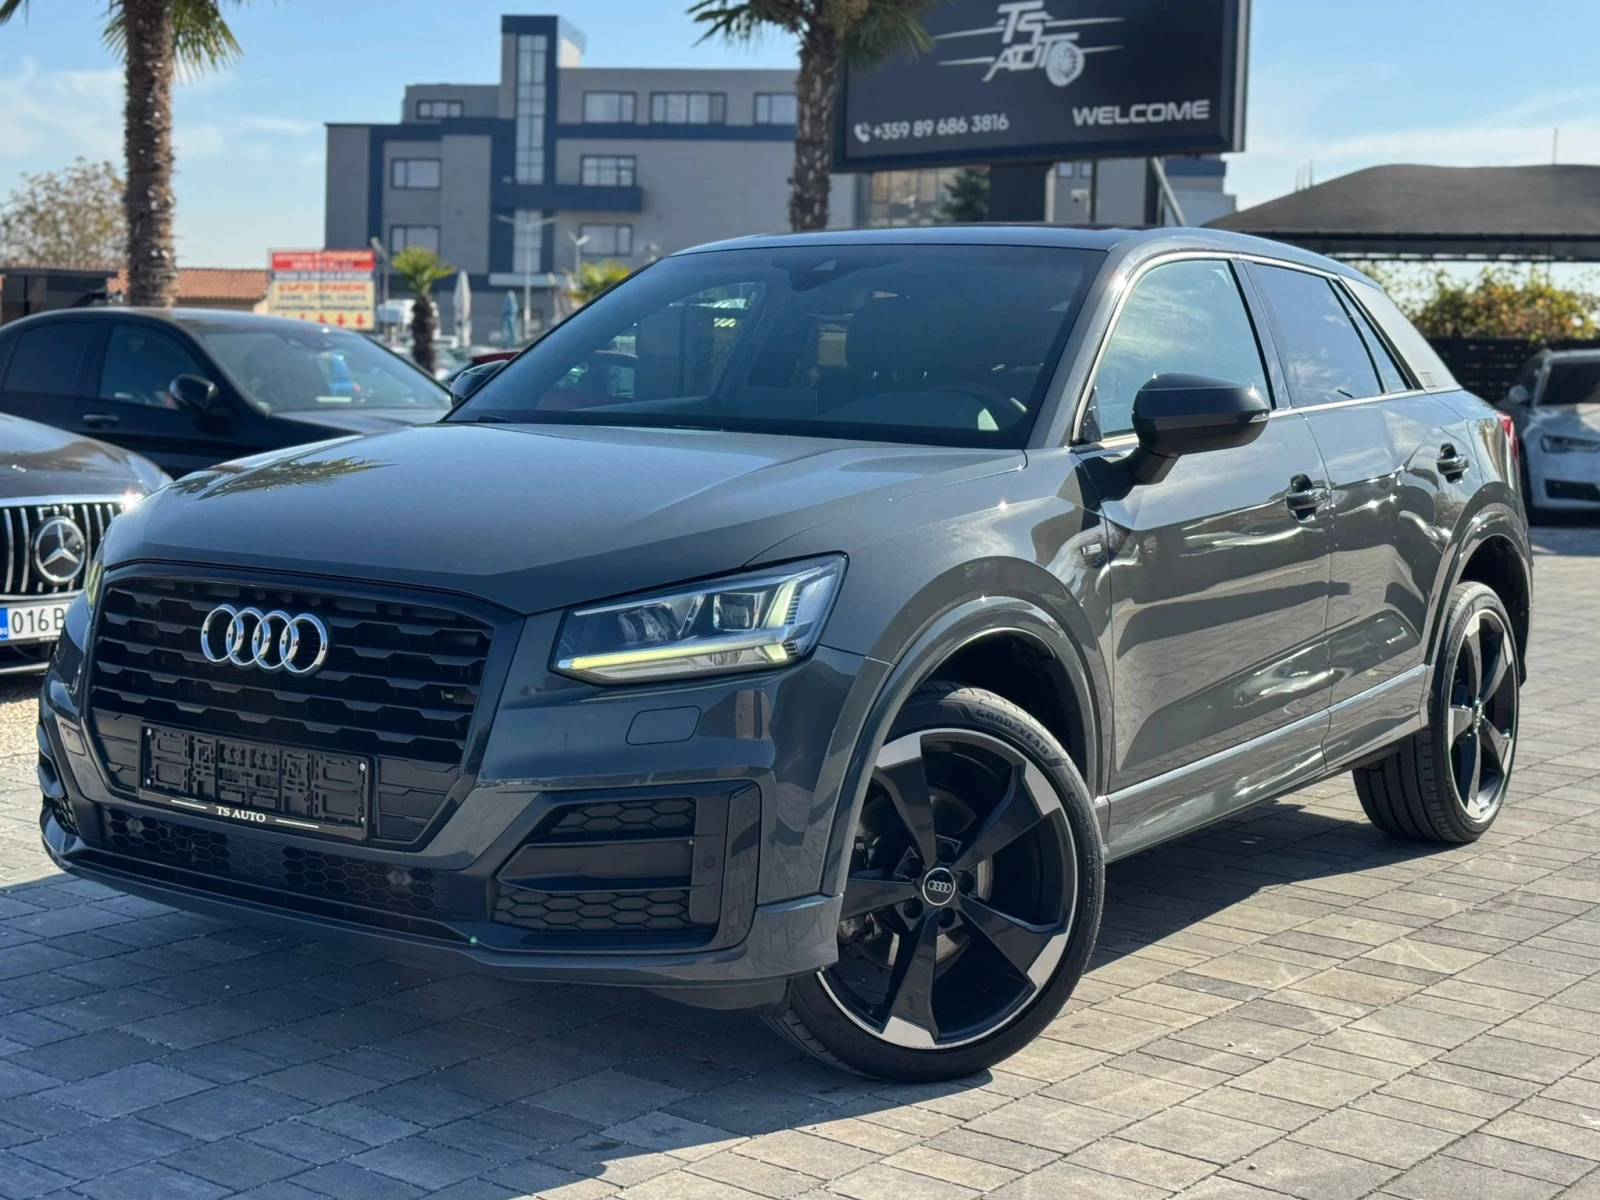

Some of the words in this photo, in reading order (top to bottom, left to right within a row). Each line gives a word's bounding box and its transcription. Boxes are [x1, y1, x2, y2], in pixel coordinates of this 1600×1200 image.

[997, 1, 1049, 50] TS
[1072, 99, 1210, 126] WELCOME
[873, 121, 909, 141] +359
[913, 119, 933, 139] 89
[937, 117, 968, 136] 686
[971, 113, 1010, 134] 3816
[216, 806, 230, 817] TS
[232, 809, 266, 823] AUTO
